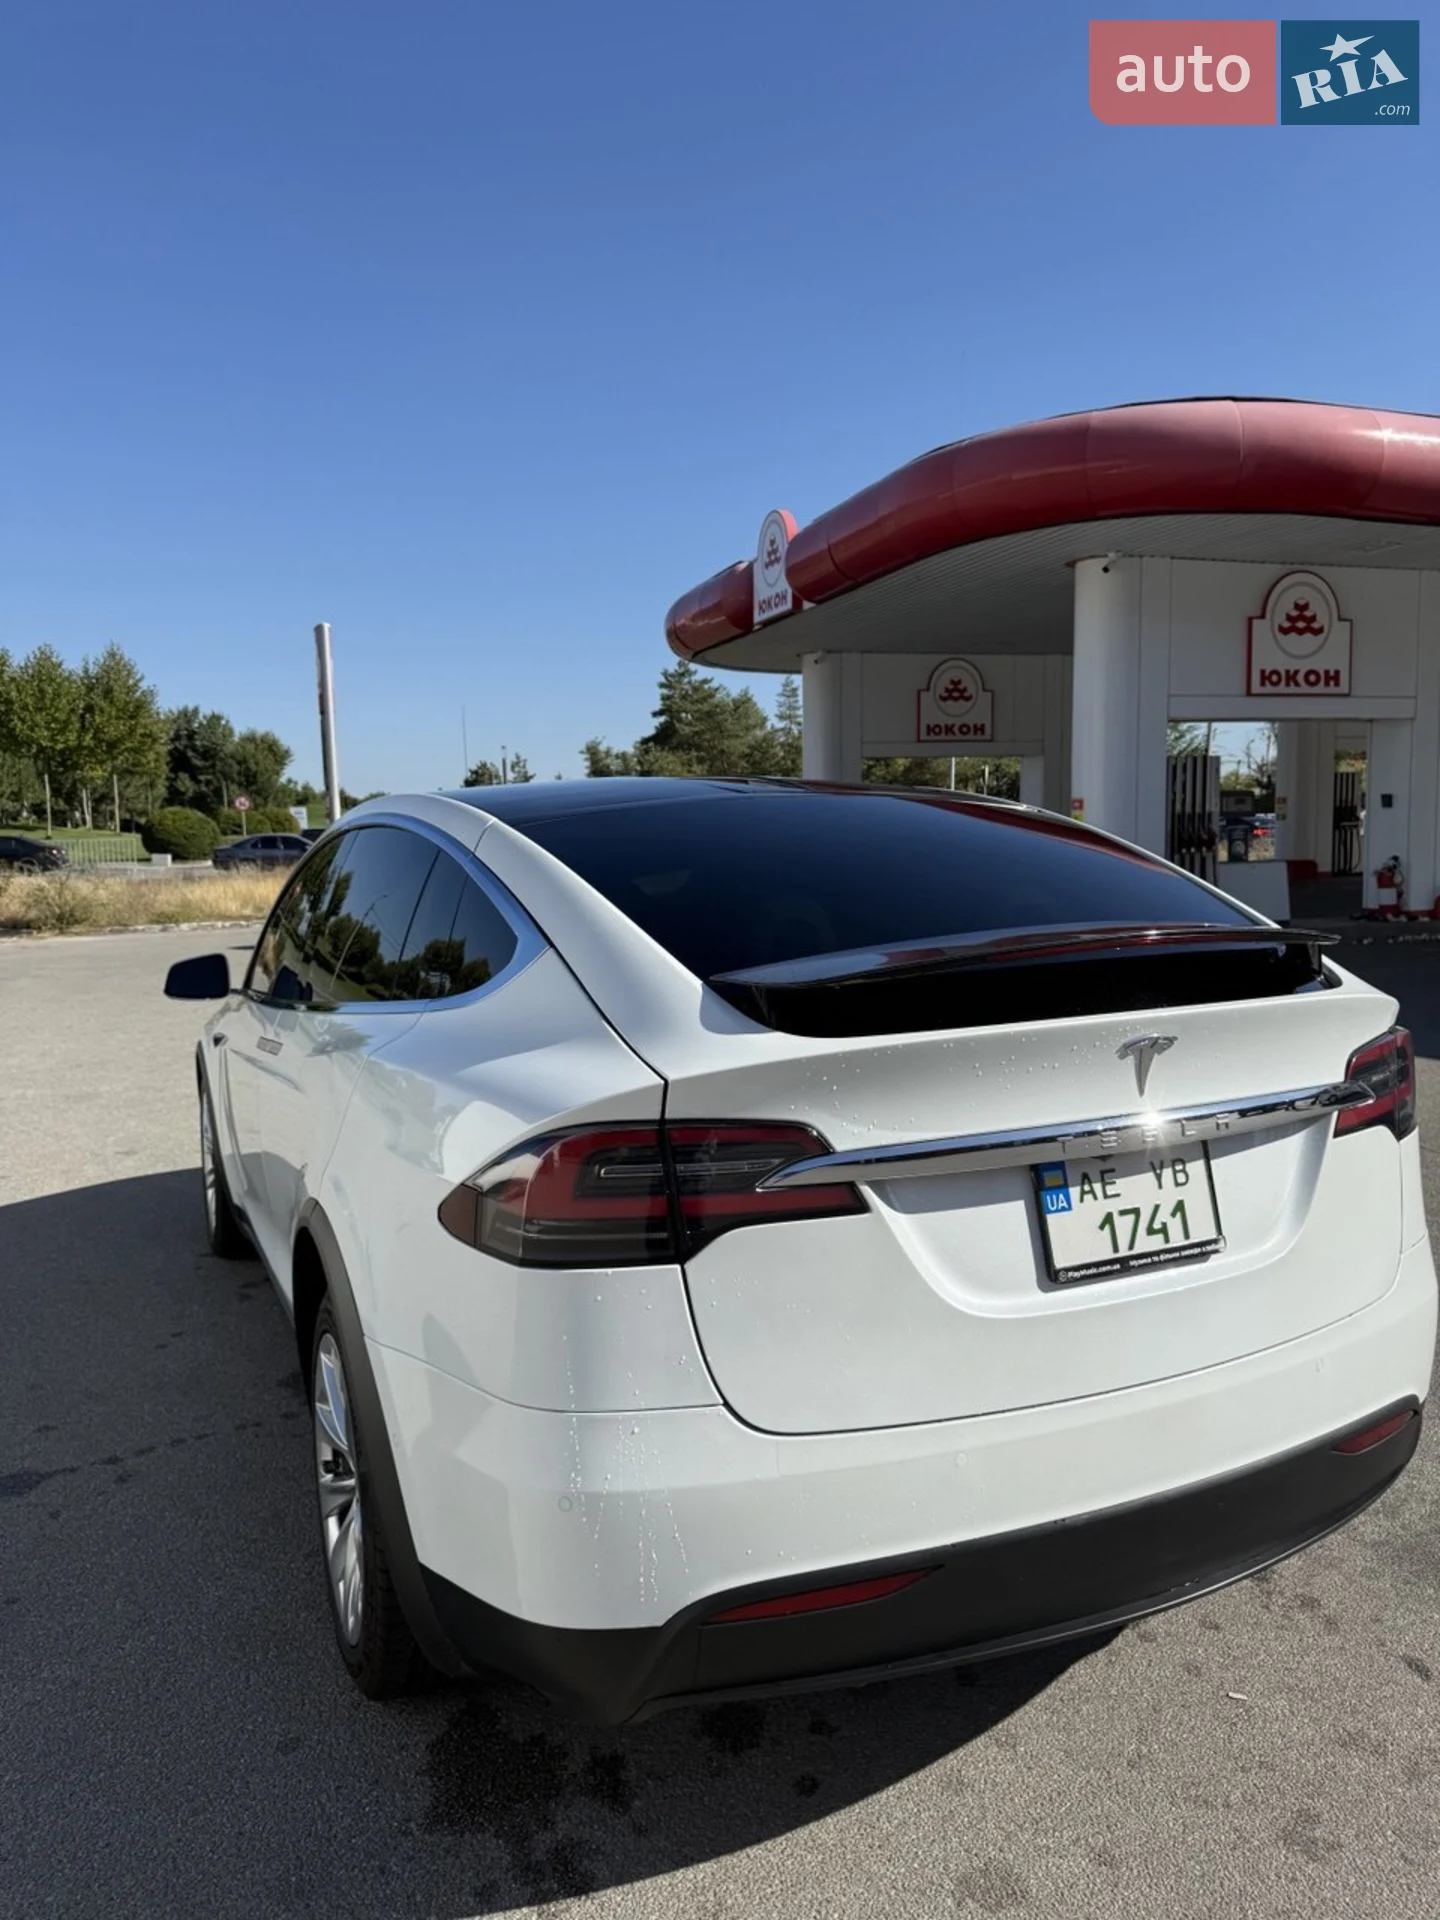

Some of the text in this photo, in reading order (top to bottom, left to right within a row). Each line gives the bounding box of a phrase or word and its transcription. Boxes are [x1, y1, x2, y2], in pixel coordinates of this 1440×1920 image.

[758, 588, 788, 616] ЮКОН
[1260, 669, 1341, 688] ЮКОН
[926, 723, 986, 737] ЮКОН
[1079, 1158, 1190, 1204] AE YB
[1046, 1193, 1069, 1211] UA
[1099, 1199, 1191, 1254] 1741
